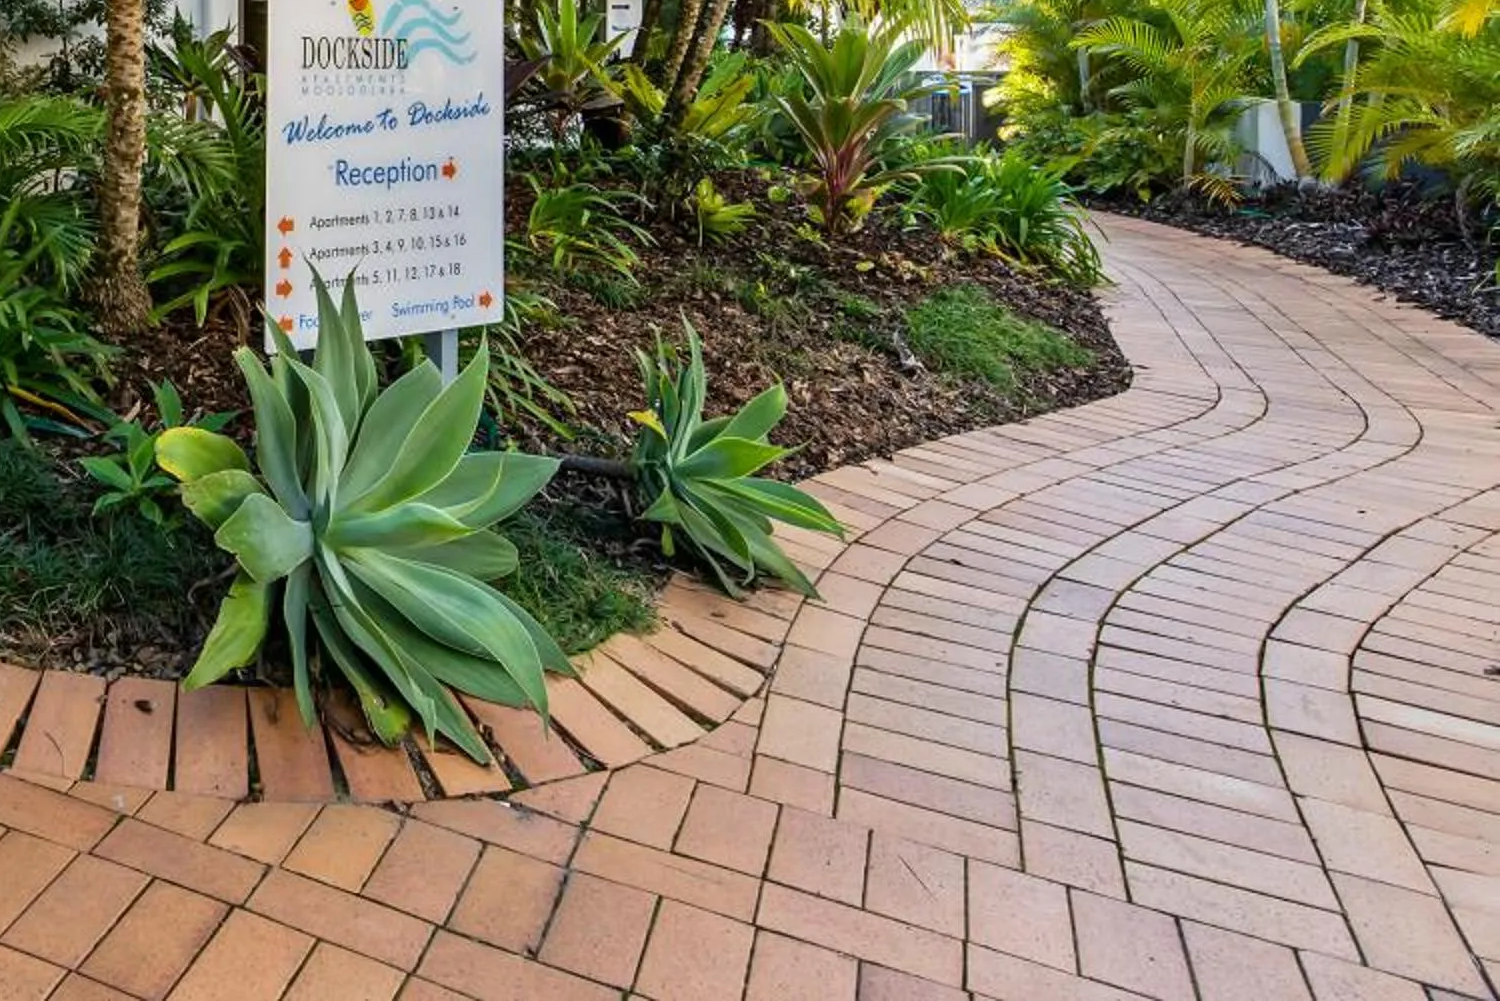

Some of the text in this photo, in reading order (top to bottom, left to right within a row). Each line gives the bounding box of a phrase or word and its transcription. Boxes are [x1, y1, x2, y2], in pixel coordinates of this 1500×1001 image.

[301, 36, 408, 69] DOCKSIDE
[283, 91, 490, 145] Welcome to Dockside
[335, 157, 437, 189] Reception
[309, 214, 370, 231] Apartments
[448, 205, 459, 217] 14
[309, 244, 370, 262] Apartments
[453, 233, 467, 246] 16
[448, 263, 461, 275] 18
[391, 299, 449, 318] Swimming
[453, 292, 475, 310] Pool
